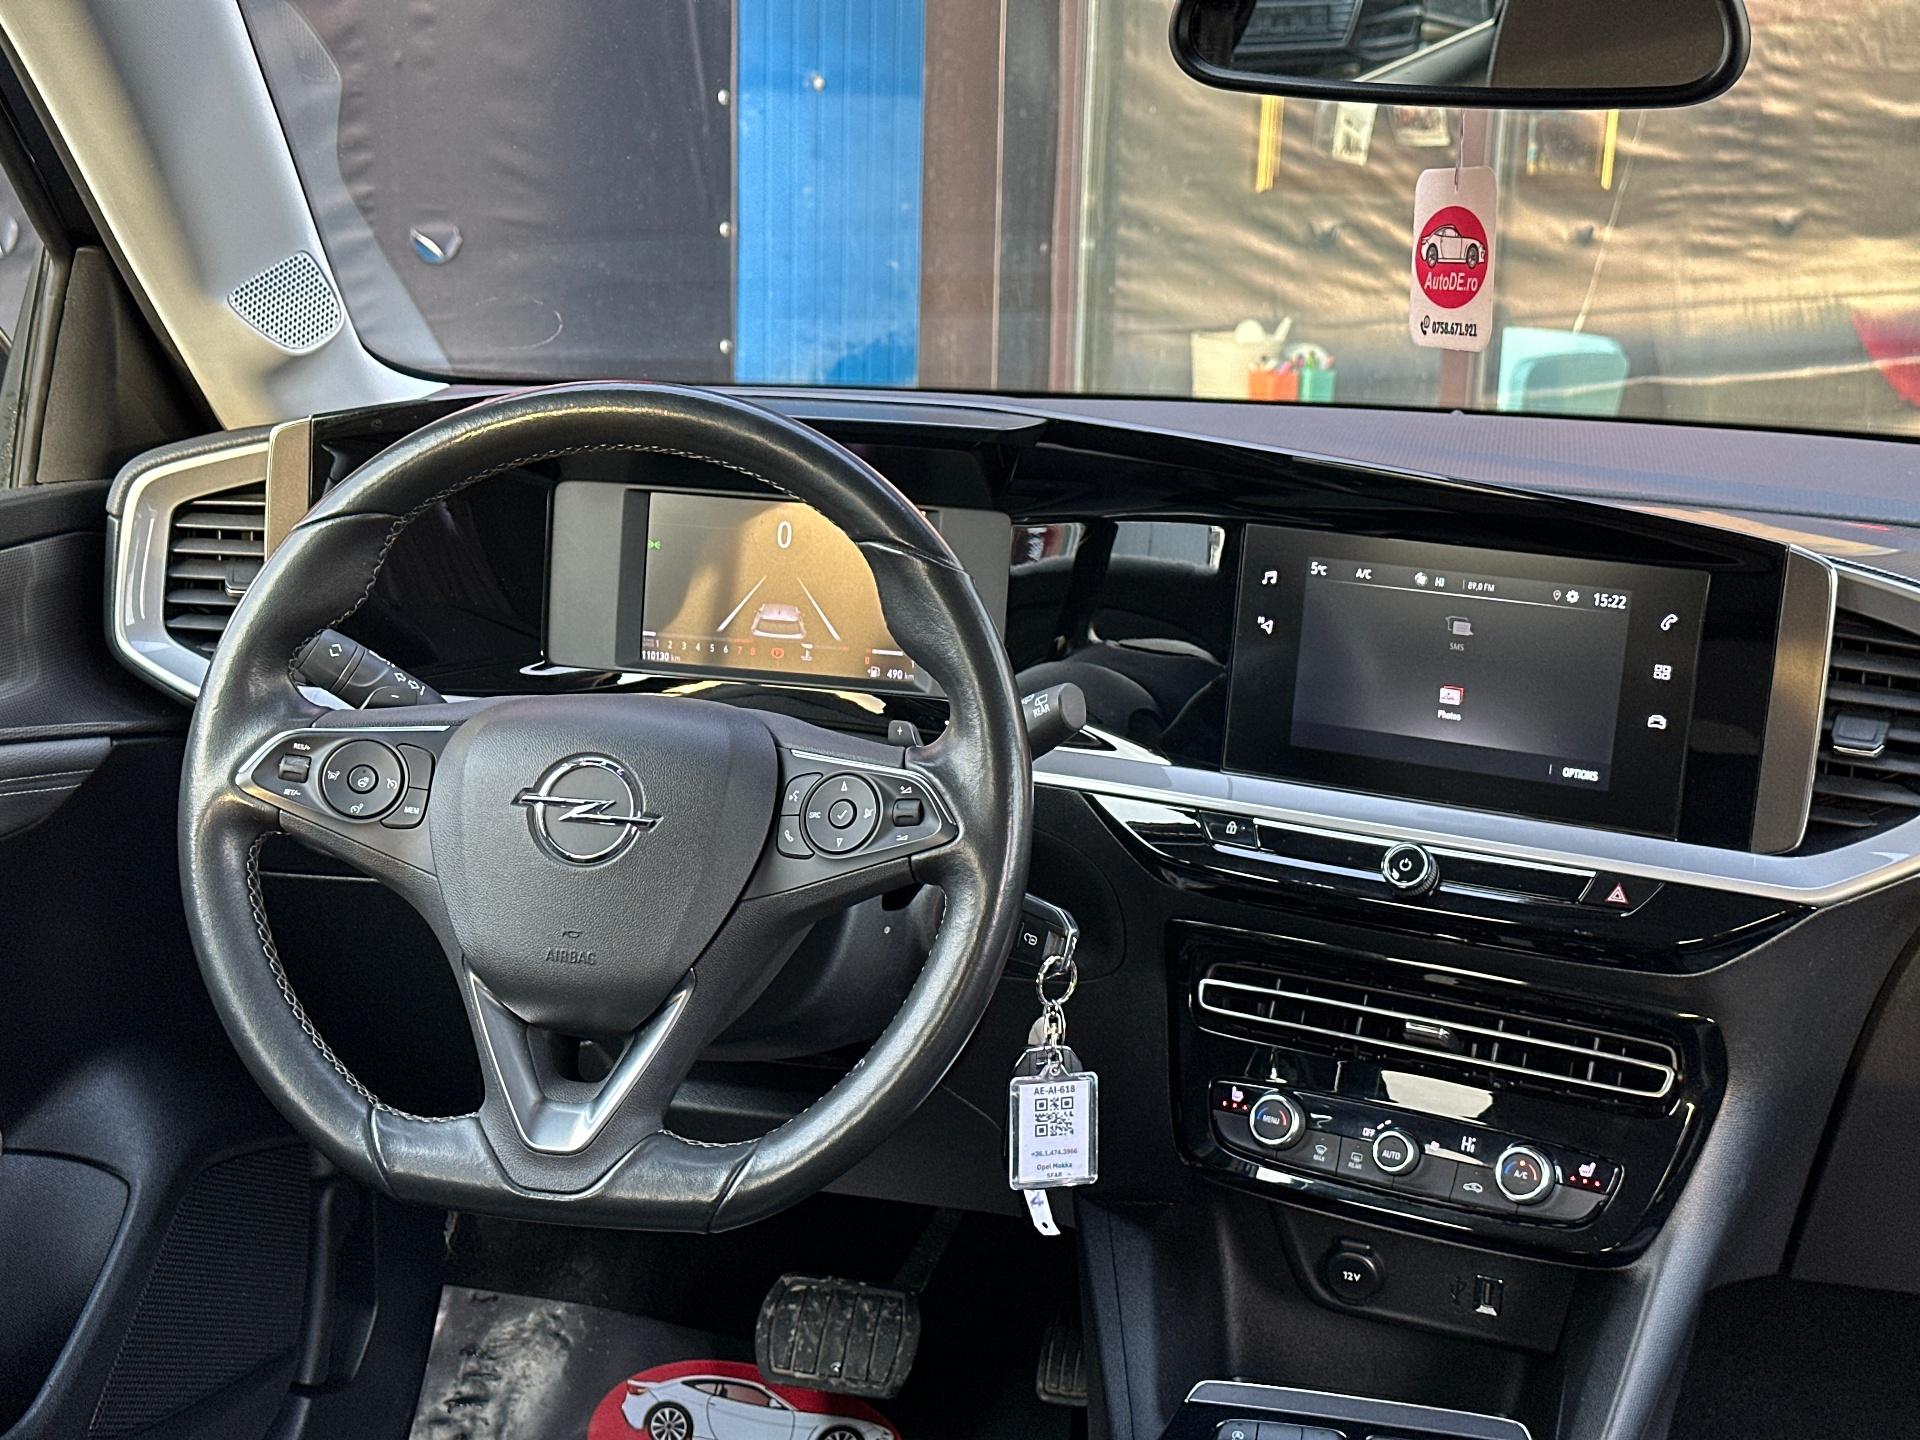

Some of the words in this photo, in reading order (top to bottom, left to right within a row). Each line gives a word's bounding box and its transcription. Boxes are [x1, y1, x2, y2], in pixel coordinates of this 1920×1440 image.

[1424, 271, 1478, 291] AutoDE.ro
[1432, 321, 1477, 337] 0758.671.921
[777, 520, 792, 549] 0
[1356, 568, 1372, 580] A/C
[1483, 582, 1495, 593] FM
[1593, 592, 1627, 610] 15:22
[1449, 642, 1465, 651] SMS
[642, 650, 670, 661] 110130
[886, 668, 903, 680] 490
[1032, 703, 1051, 719] REAR
[1437, 709, 1462, 722] Photos
[1562, 766, 1599, 782] OPTIONS
[1033, 1085, 1075, 1095] AE-AI-618
[1381, 1149, 1401, 1161] AUTO
[1036, 1163, 1052, 1171] Opel
[1513, 1169, 1529, 1180] A/C
